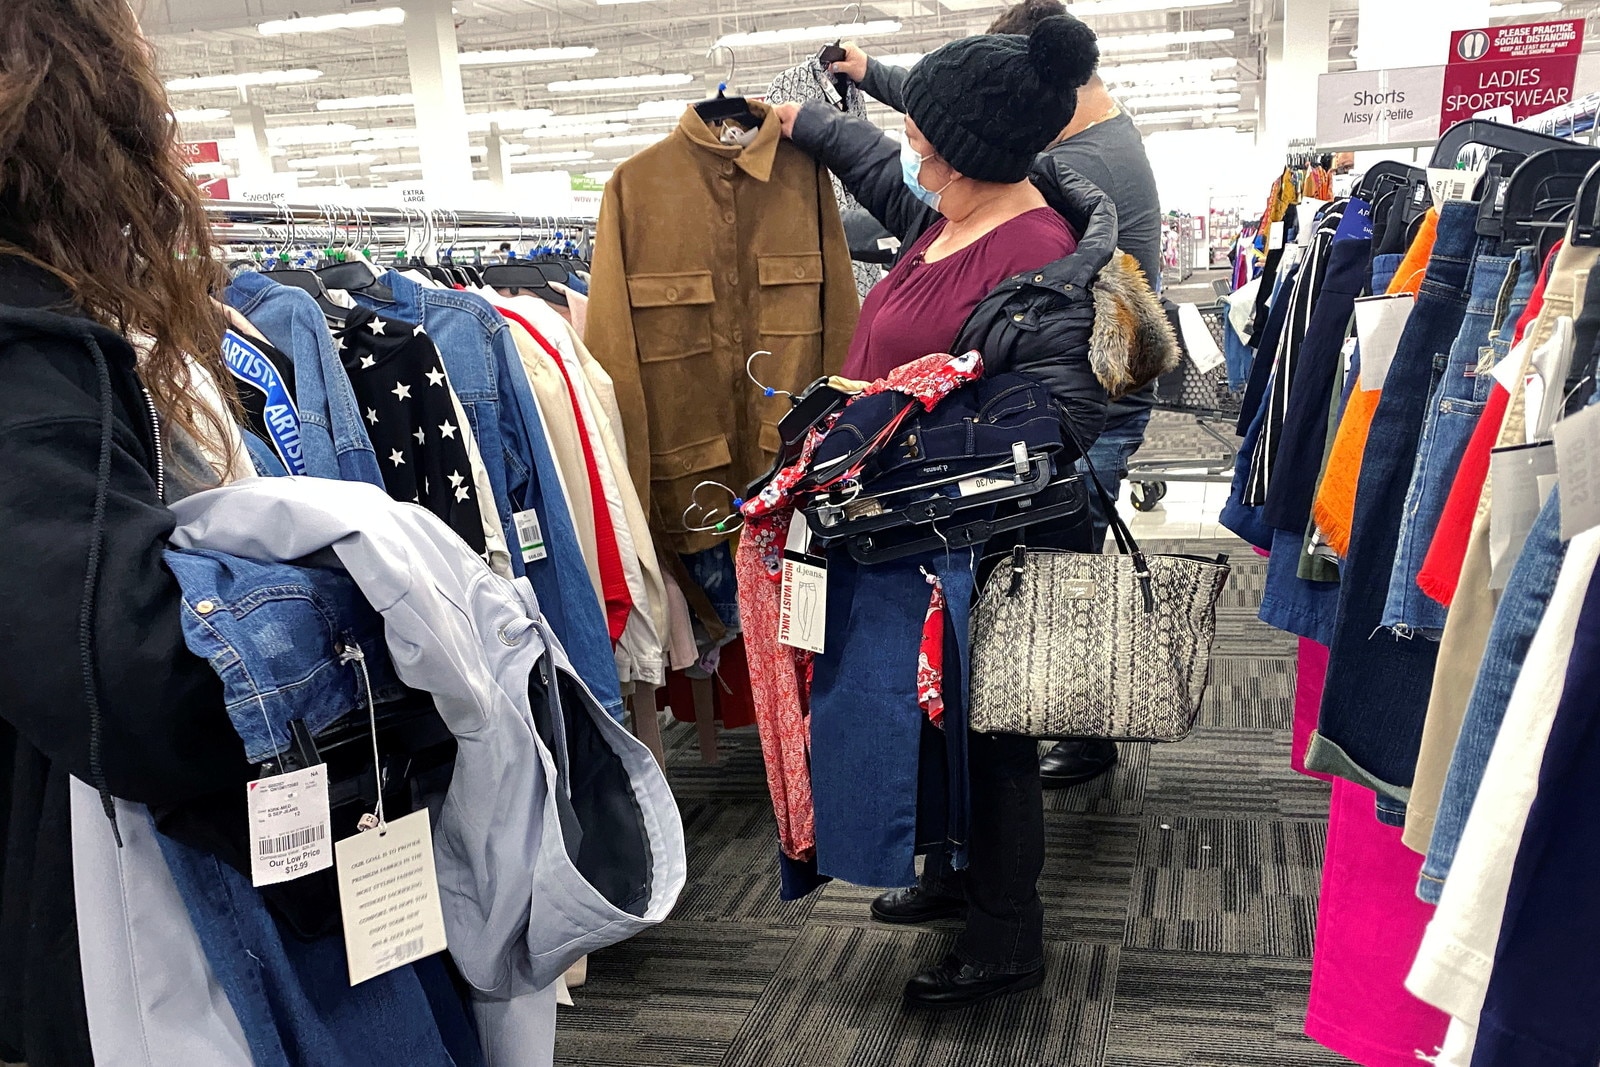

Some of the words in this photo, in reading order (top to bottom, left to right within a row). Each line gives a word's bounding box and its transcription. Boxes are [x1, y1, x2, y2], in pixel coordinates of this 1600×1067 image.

[1494, 36, 1525, 46] SOCIAL
[1526, 31, 1576, 43] DISTANCING
[1499, 27, 1531, 37] PLEASE
[1532, 23, 1574, 34] PRACTICE
[1479, 68, 1541, 89] LADIES
[1353, 89, 1405, 106] Shorts
[1446, 87, 1569, 112] SPORTSWEAR
[1343, 112, 1374, 125] Missy
[785, 562, 793, 582] HIGH
[782, 585, 792, 611] WAIST
[780, 614, 791, 640] ANKLE
[269, 859, 284, 868] Our
[286, 855, 302, 865] Low
[302, 849, 321, 860] Price
[285, 861, 309, 874] $12.99
